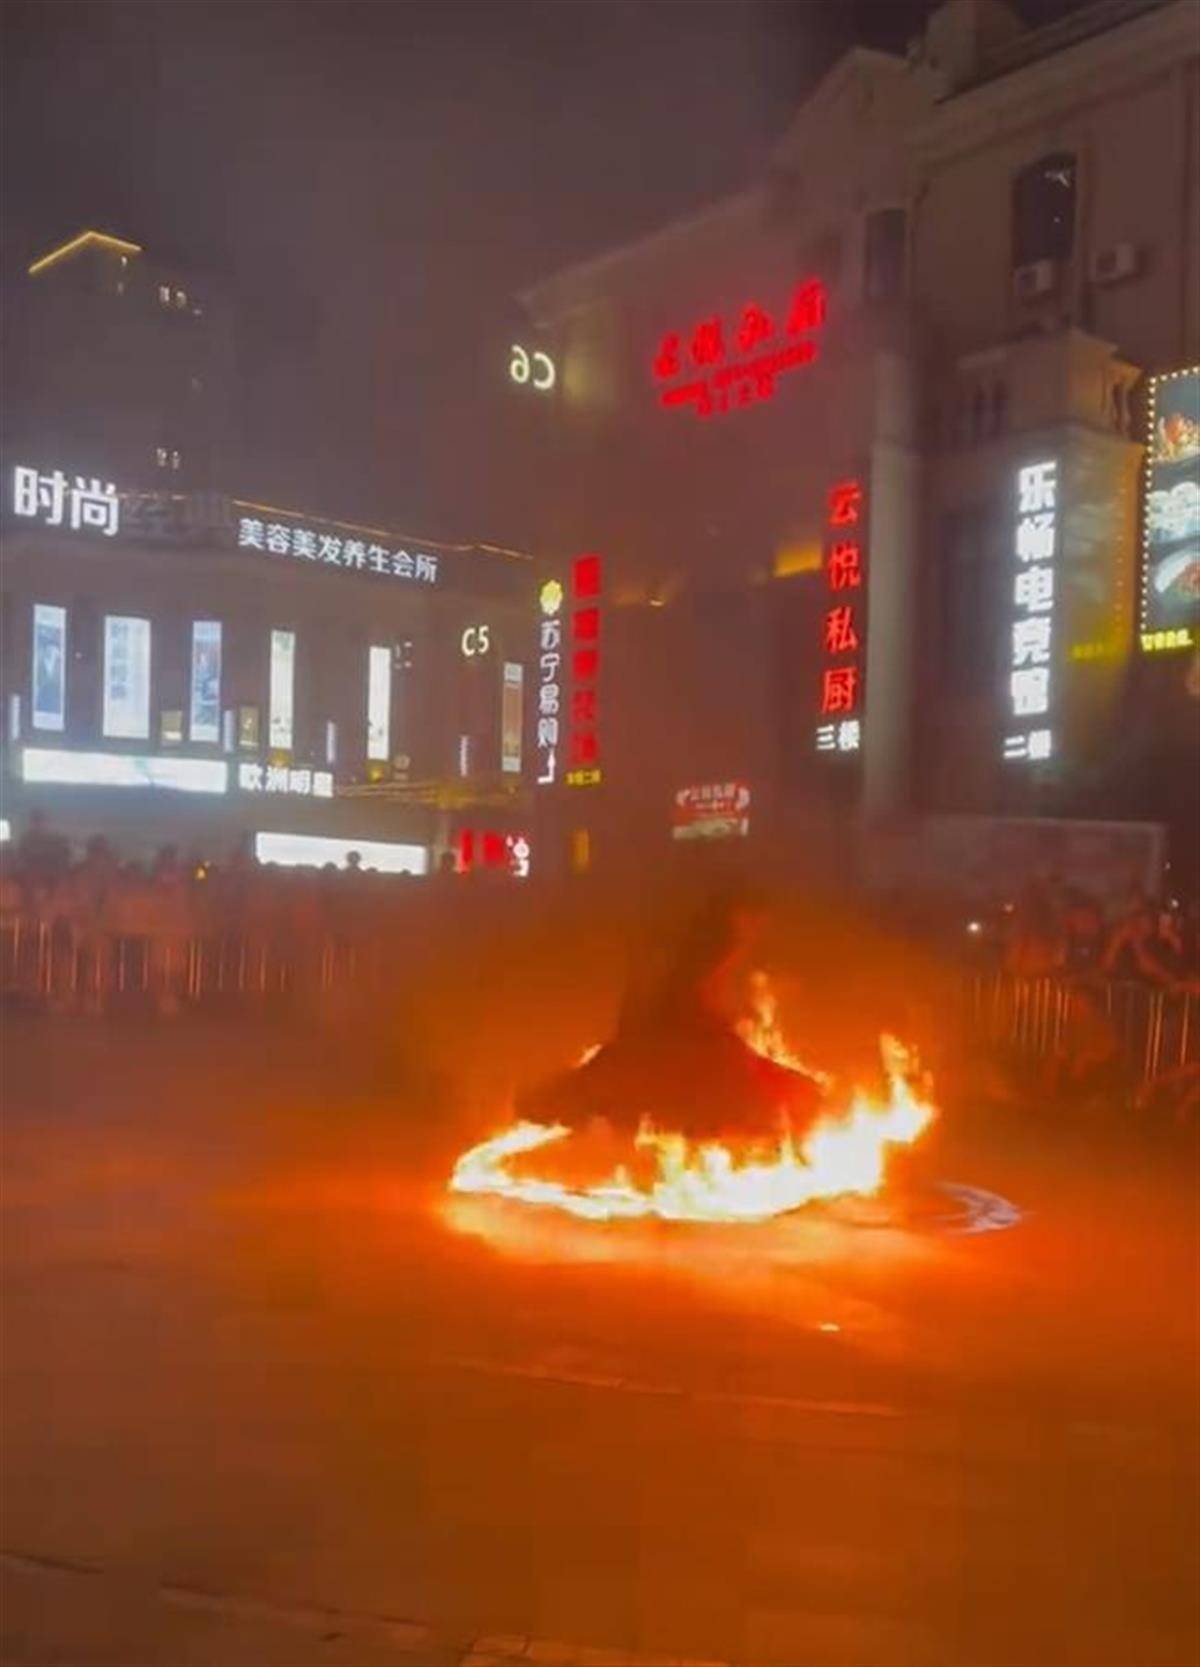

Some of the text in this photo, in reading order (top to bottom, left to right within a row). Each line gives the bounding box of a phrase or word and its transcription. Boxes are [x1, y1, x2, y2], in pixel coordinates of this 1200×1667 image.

[14, 466, 120, 537] 时尚
[238, 517, 438, 582] 美容美发养生会所
[822, 481, 862, 713] 云悦私厨
[461, 626, 490, 657] C5
